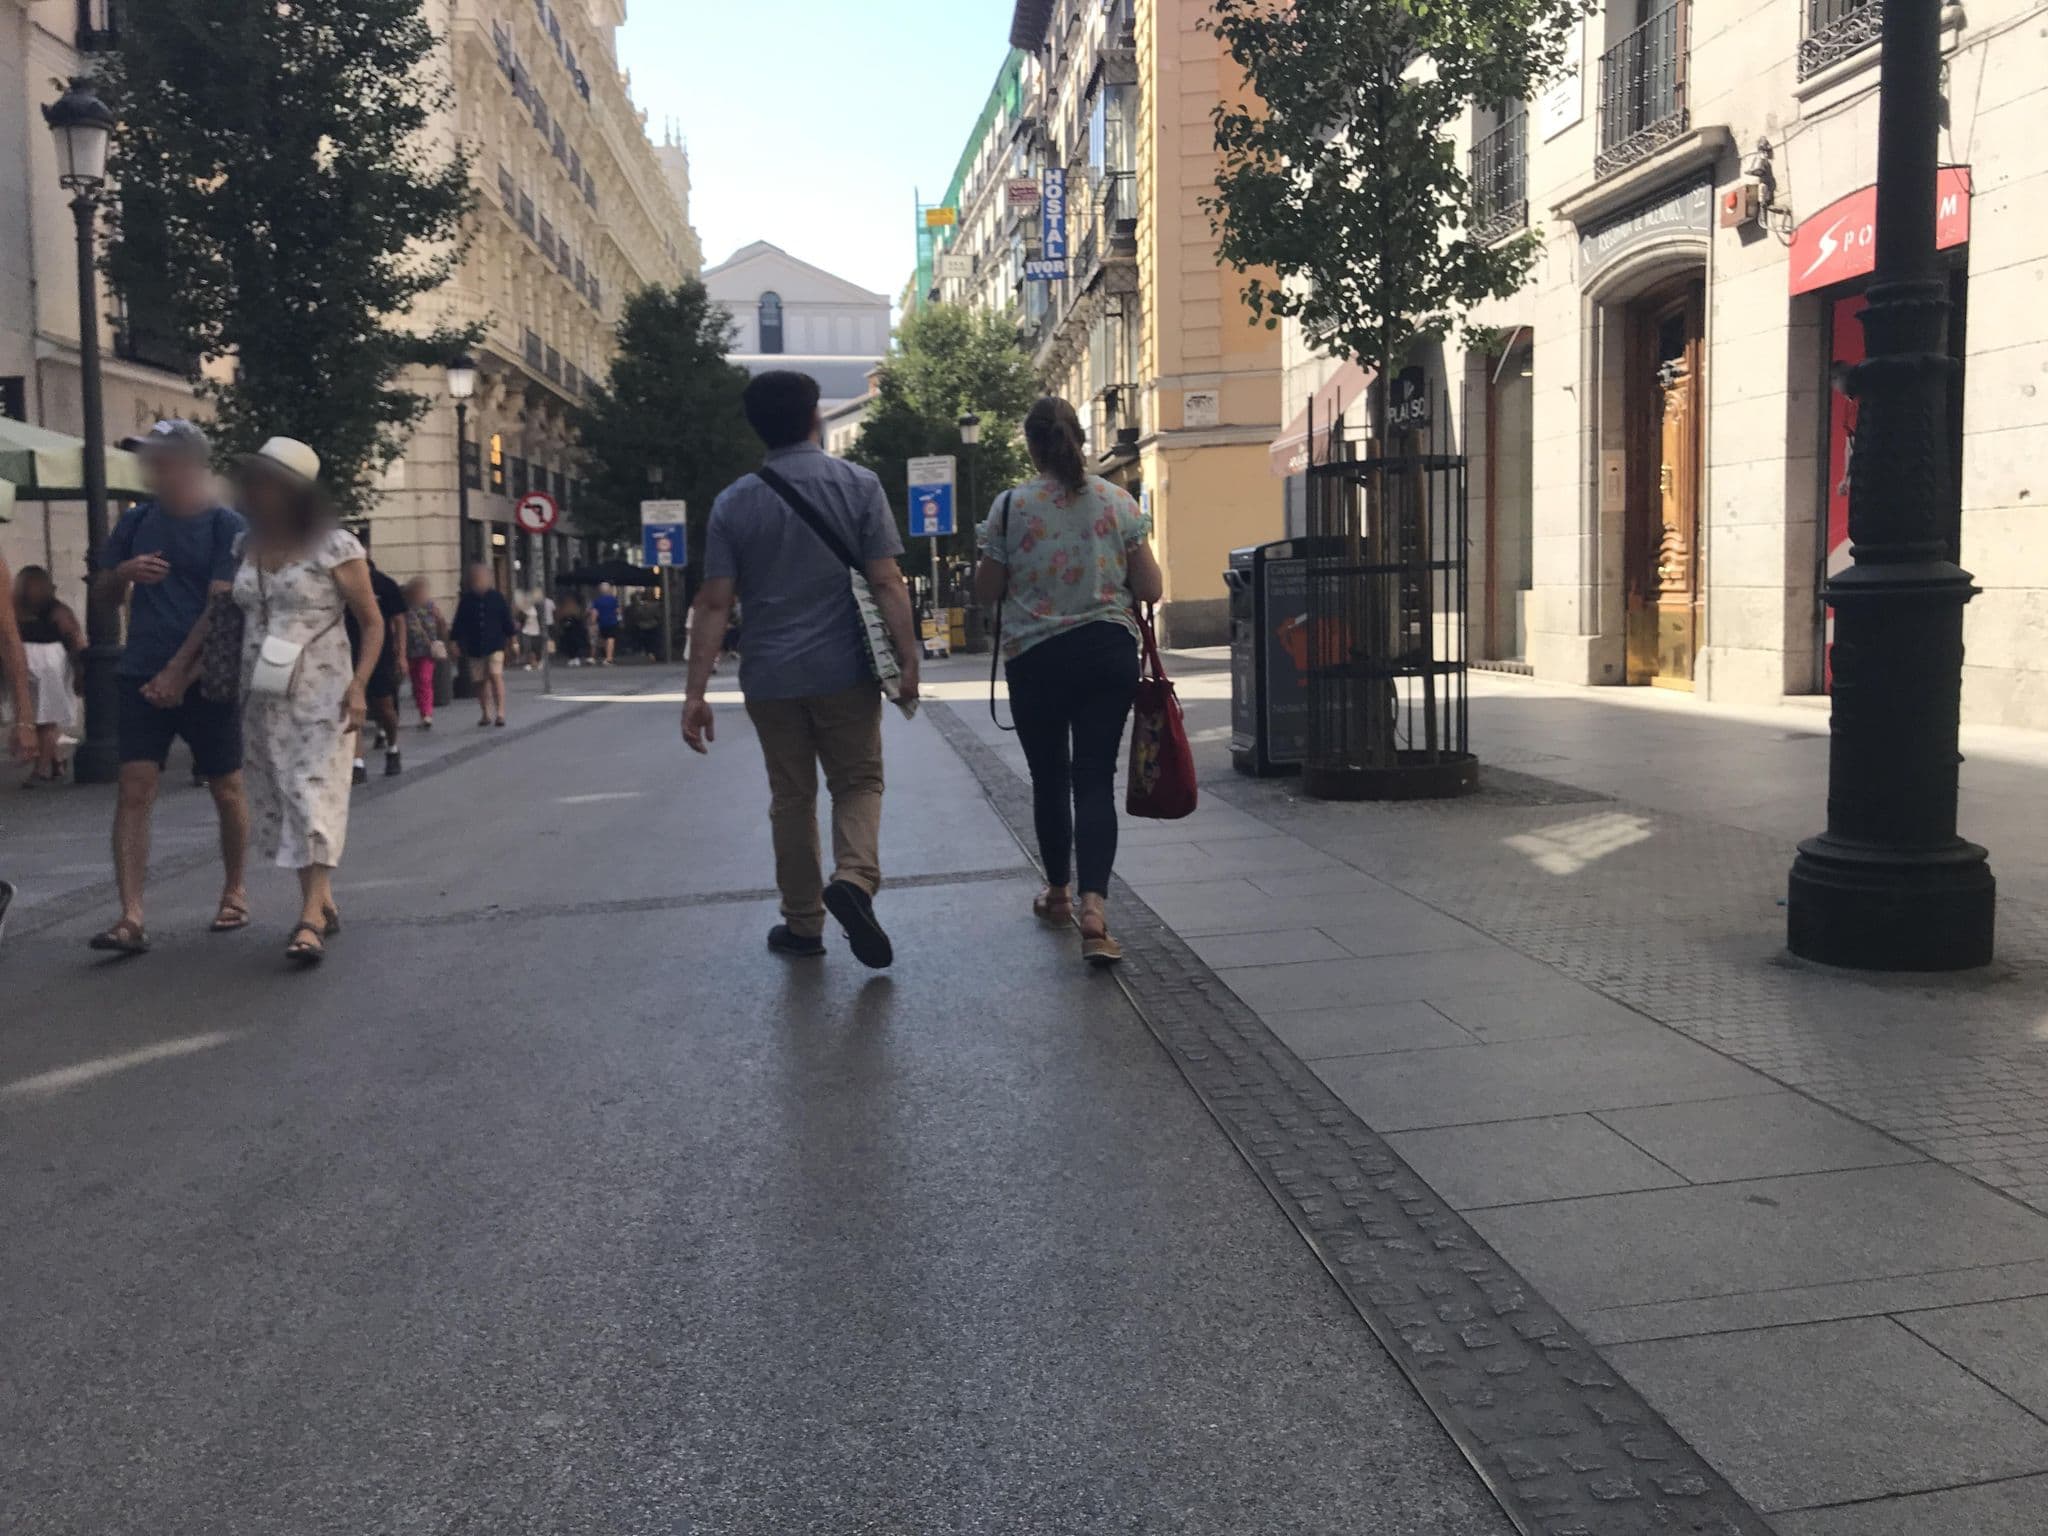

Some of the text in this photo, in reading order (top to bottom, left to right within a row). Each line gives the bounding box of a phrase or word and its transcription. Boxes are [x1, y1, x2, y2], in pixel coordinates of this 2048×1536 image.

[1045, 169, 1064, 259] HOSTAL
[1800, 194, 1958, 281] SPOM
[1026, 260, 1065, 274] IVOR
